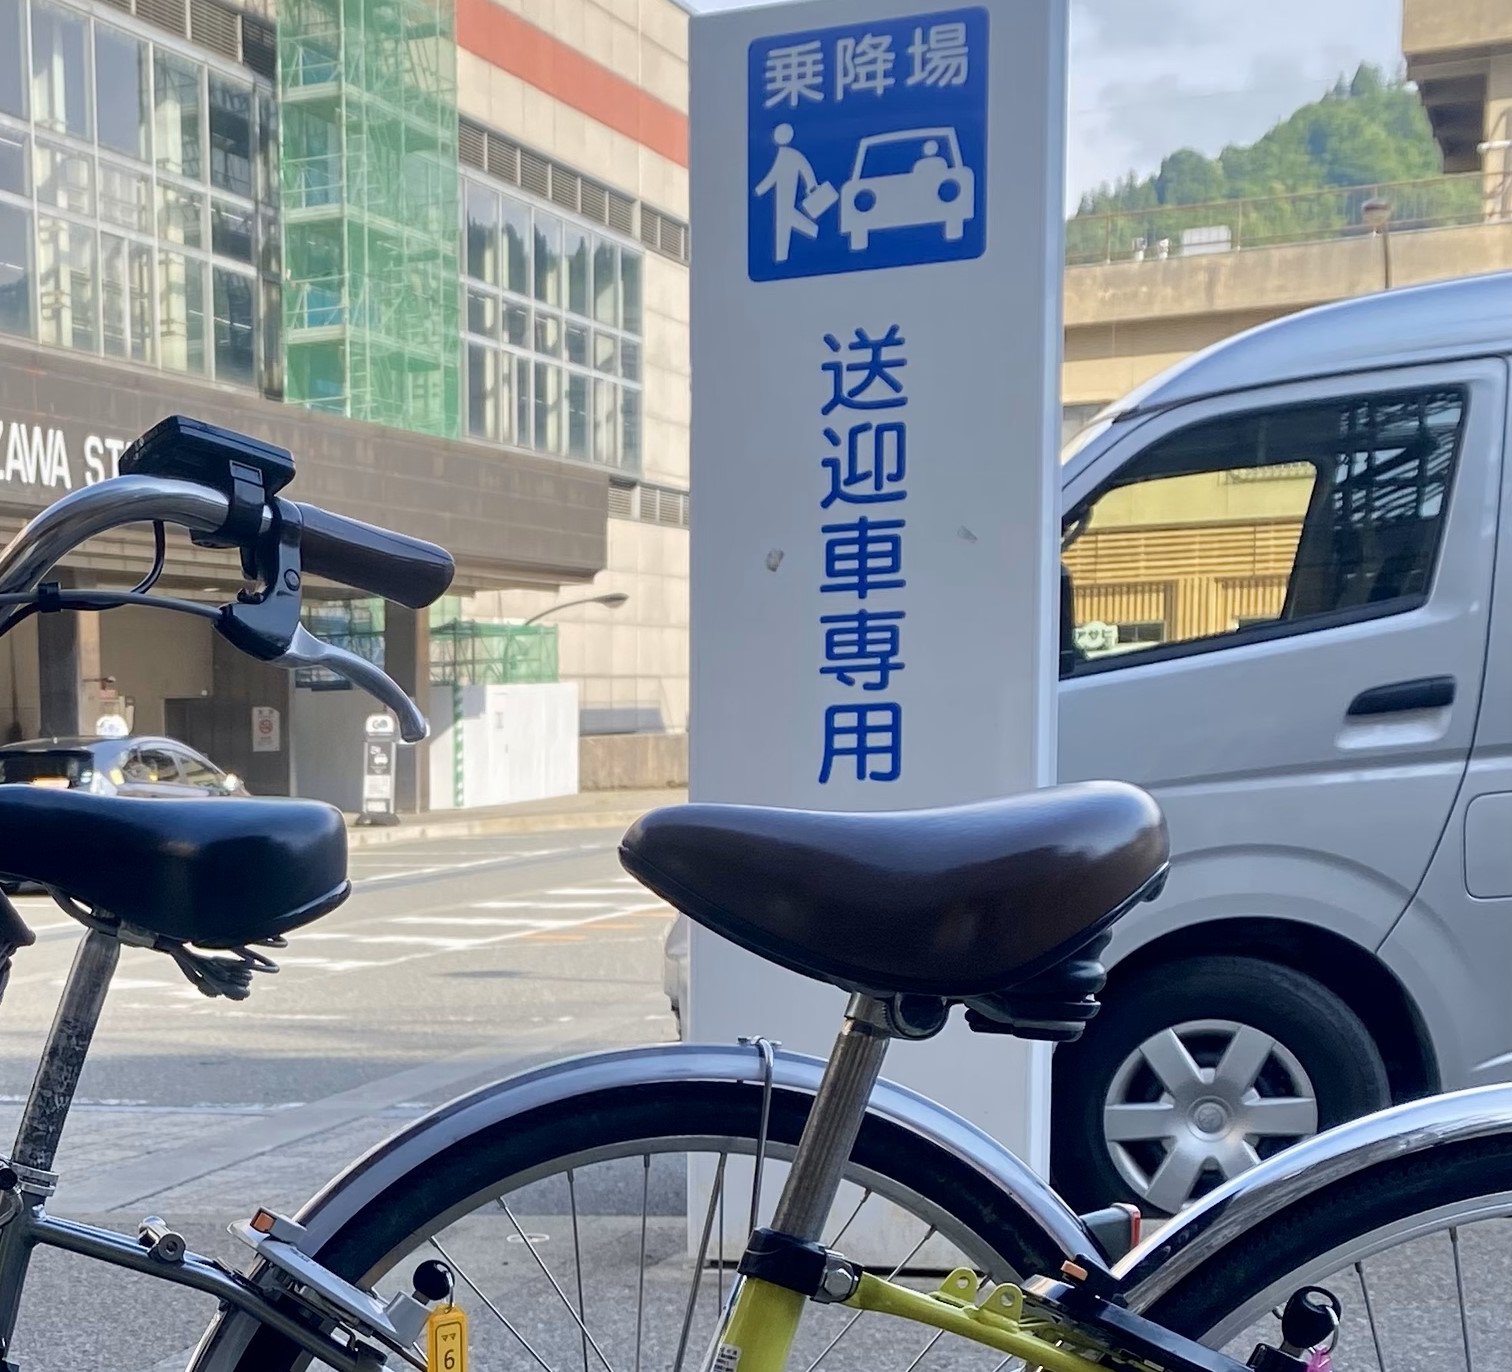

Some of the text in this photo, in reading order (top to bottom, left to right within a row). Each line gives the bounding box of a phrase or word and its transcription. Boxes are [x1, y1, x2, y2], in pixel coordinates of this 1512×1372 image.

[764, 22, 969, 108] 乗降場
[85, 436, 135, 488] ST
[818, 325, 908, 784] 送迎車専用
[443, 1348, 456, 1371] 6
